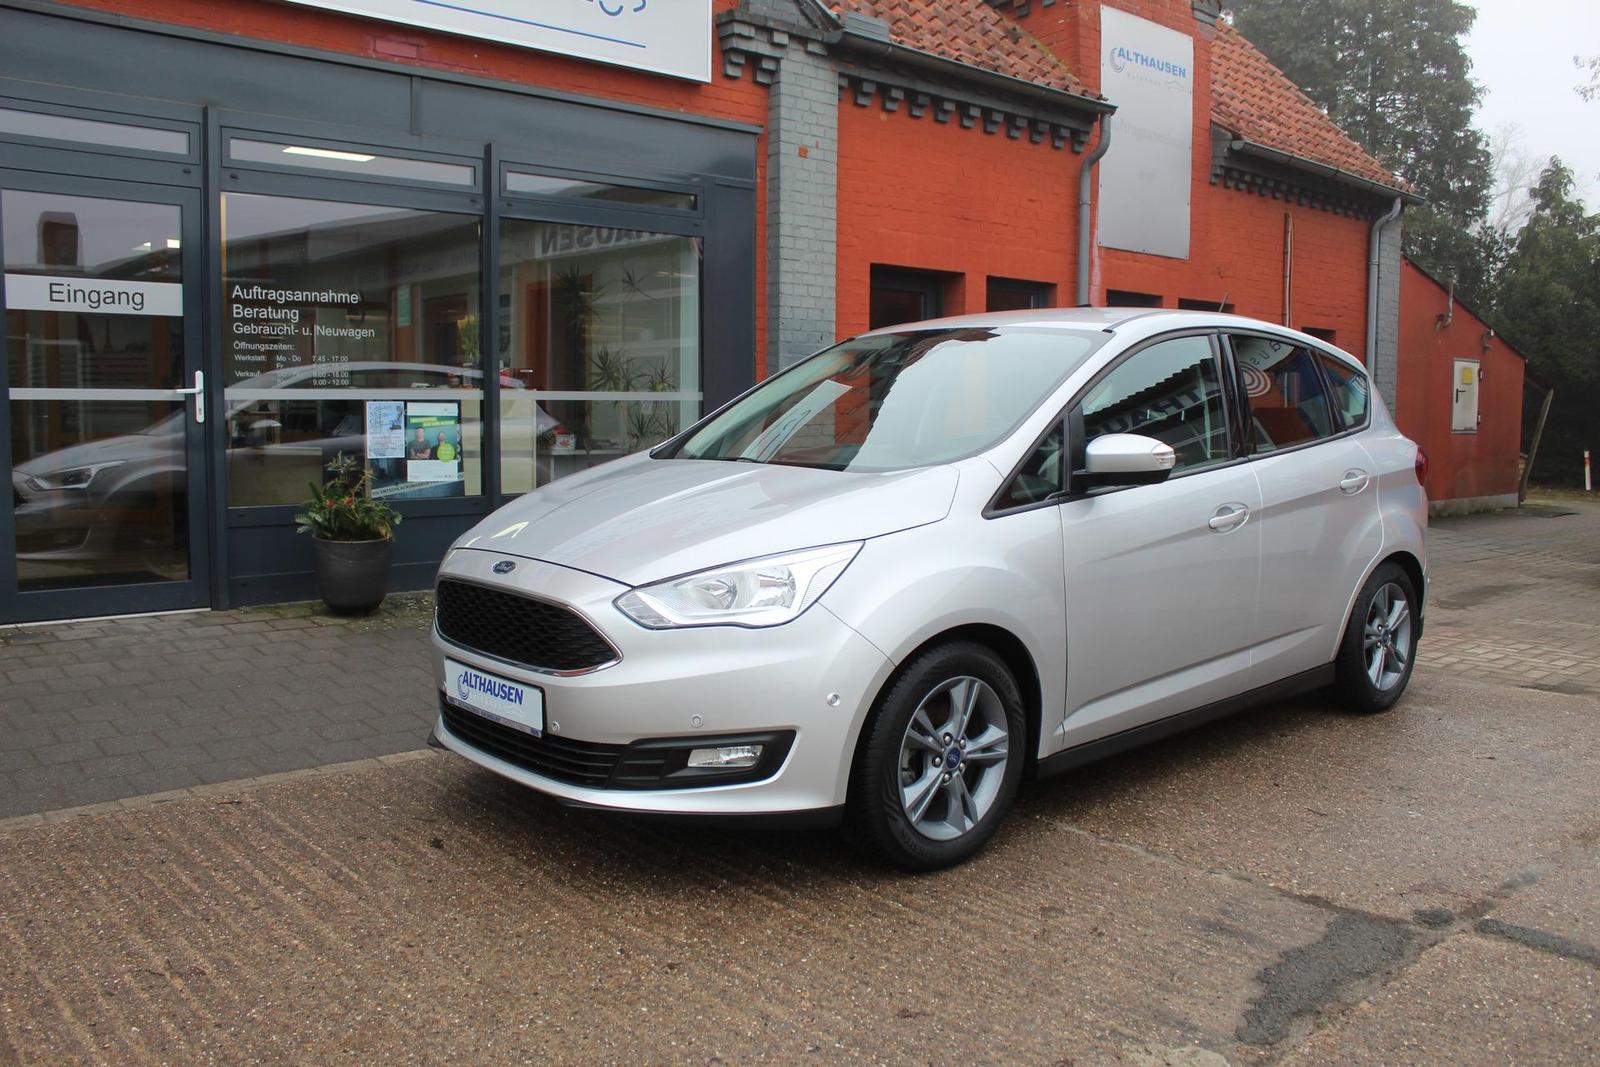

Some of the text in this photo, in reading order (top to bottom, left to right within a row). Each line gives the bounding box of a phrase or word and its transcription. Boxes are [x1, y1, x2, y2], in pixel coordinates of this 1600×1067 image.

[1117, 47, 1186, 79] ALTHAUSEN
[48, 282, 144, 311] Eingang
[232, 285, 359, 304] Auftragsannahme
[233, 304, 299, 323] Beratung
[233, 322, 375, 339] Gebraucht- u. Neuwagen
[233, 341, 295, 352] Öffnungszeiten:
[276, 354, 286, 362] Mo
[462, 670, 524, 705] ALTHAUSEN
